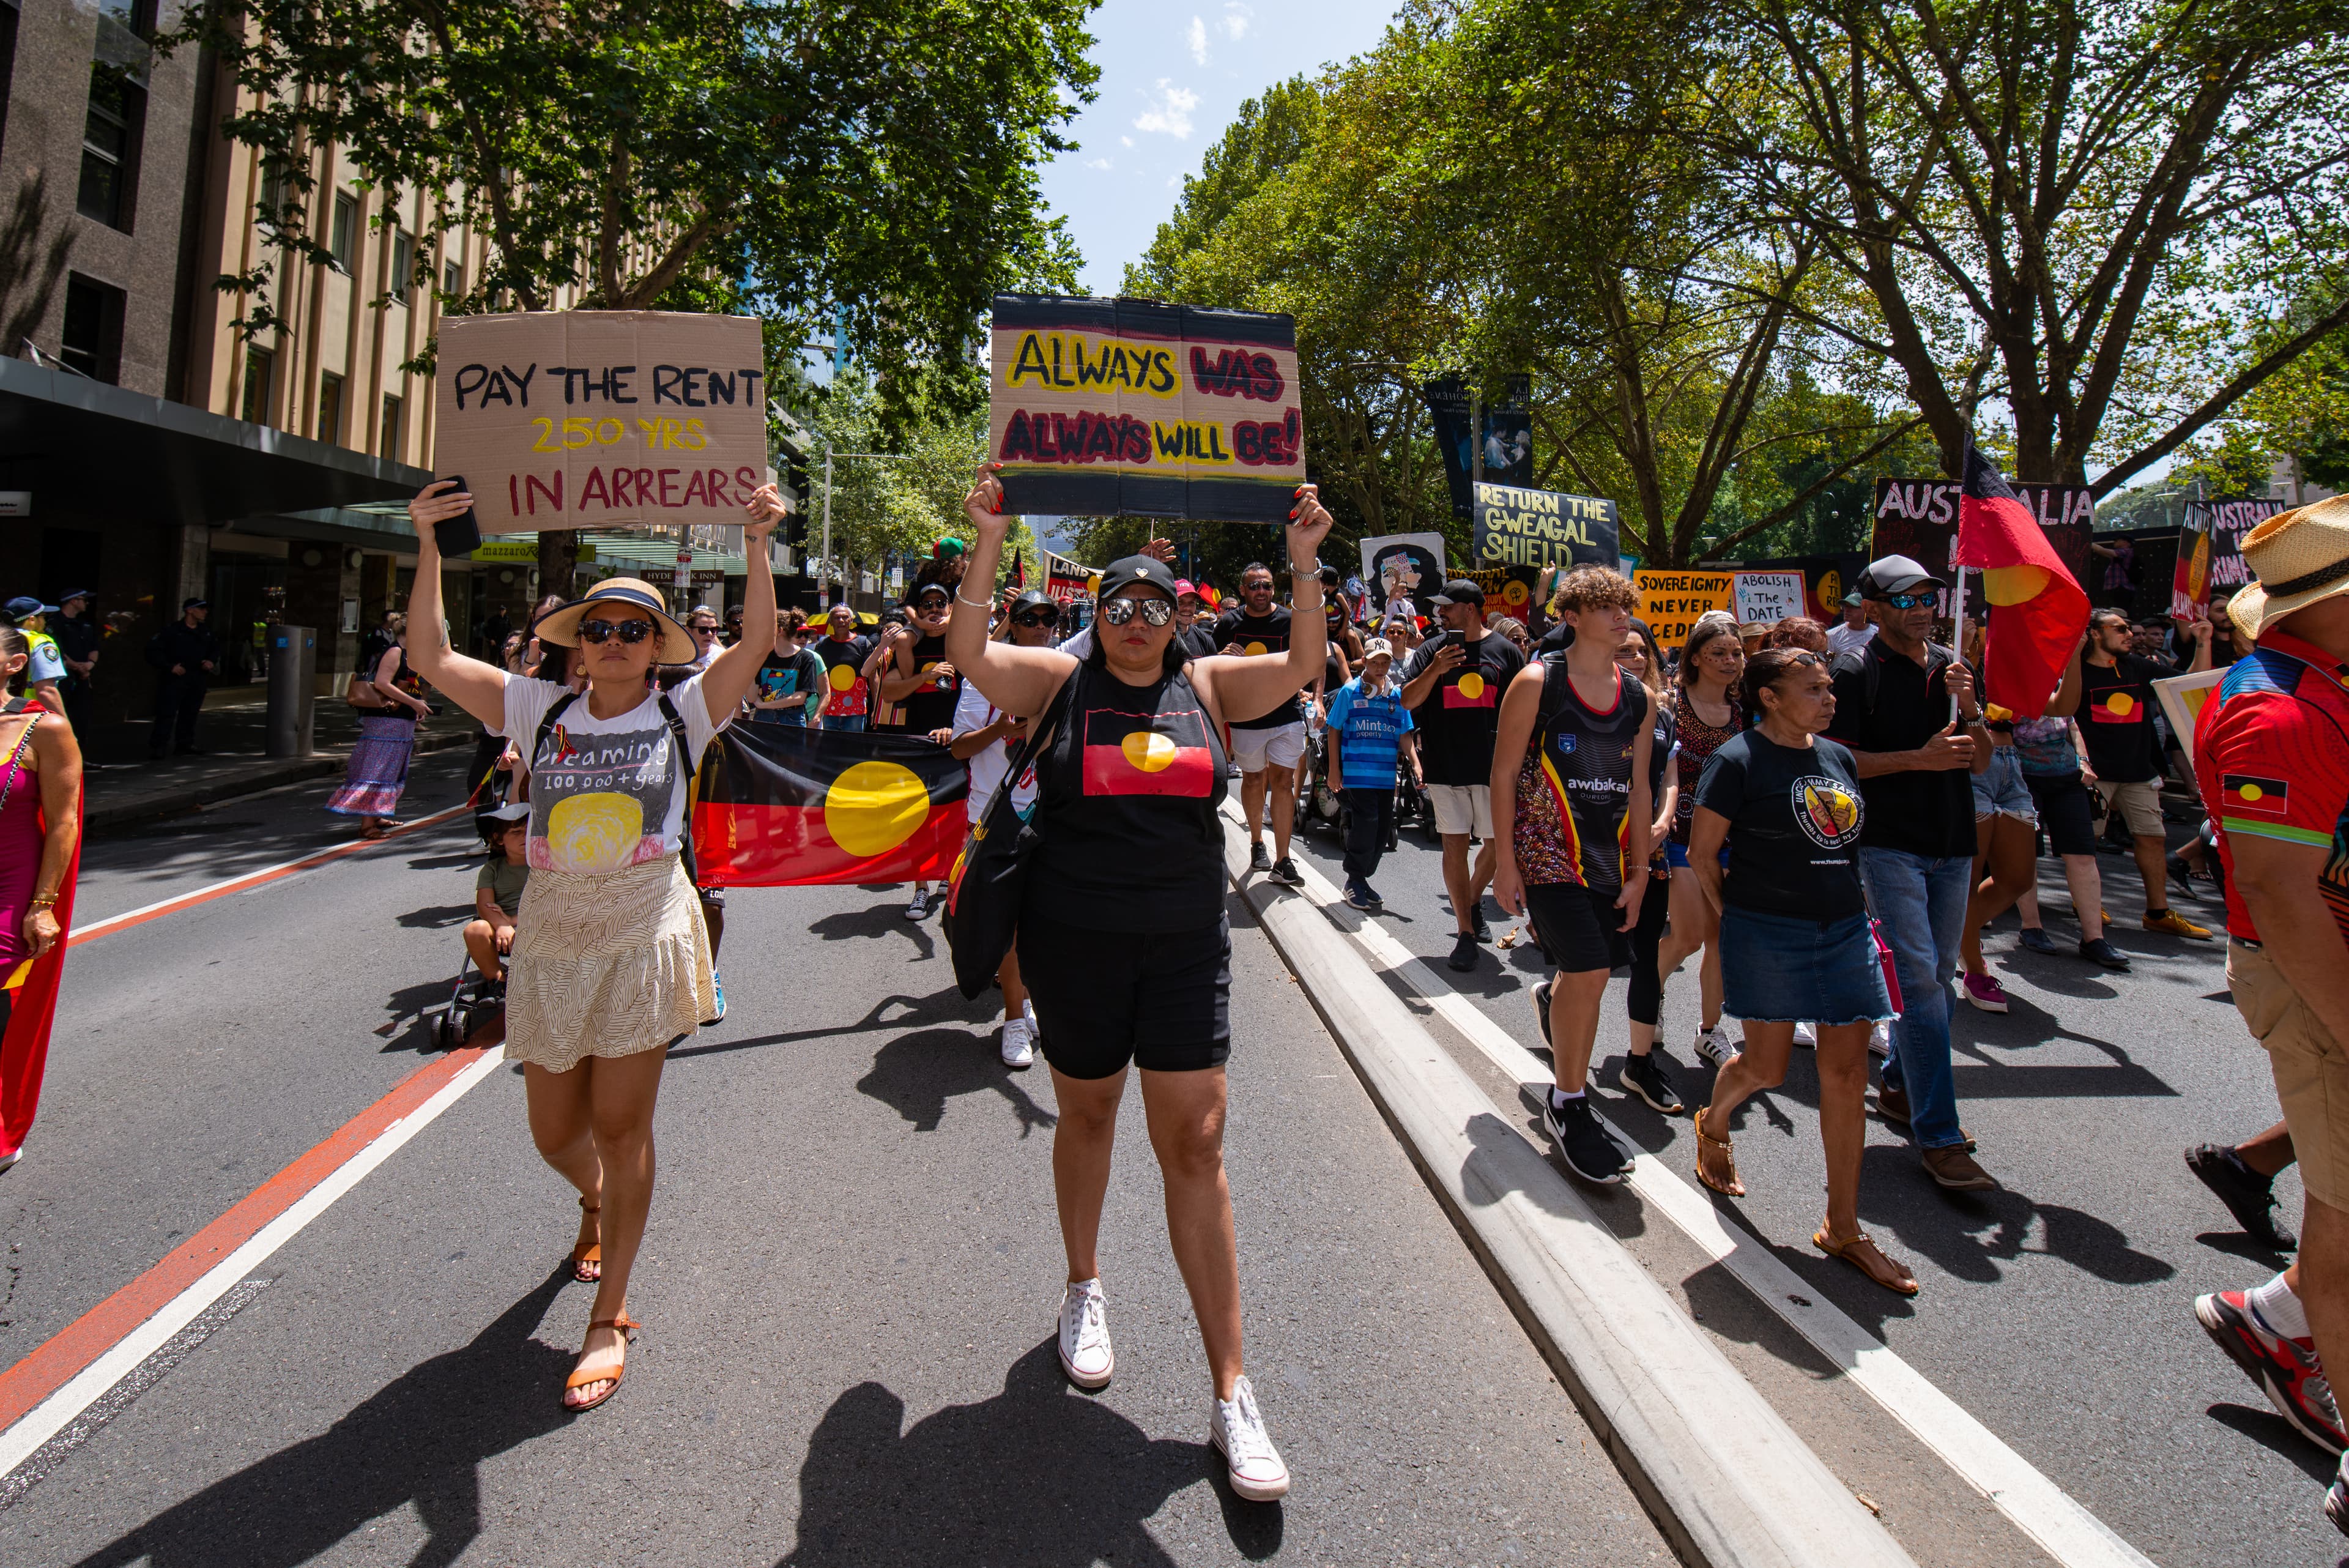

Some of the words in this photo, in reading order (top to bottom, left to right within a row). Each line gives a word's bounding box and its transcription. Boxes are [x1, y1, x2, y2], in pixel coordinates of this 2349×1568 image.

[1009, 331, 1179, 396] ALWAYS
[1191, 346, 1284, 400] WAS
[455, 363, 536, 411] PAY
[546, 366, 639, 405] THE
[653, 364, 763, 407] RENT
[531, 417, 625, 453] 250
[637, 416, 707, 451] YRS
[1001, 409, 1151, 463] ALWAYS
[1154, 420, 1232, 464] WILL
[1234, 408, 1301, 465] BE!
[509, 469, 563, 516] IN
[577, 466, 758, 511] ARREARS
[1479, 485, 1559, 515] RETURN
[1566, 497, 1611, 522] THE
[1877, 481, 2095, 526] AUSALIA
[1485, 508, 1597, 546] GWEAGAL
[2183, 502, 2211, 533] ALWAYS
[482, 546, 526, 556] mazzaro
[1482, 532, 1572, 571] SHIELD
[1052, 557, 1090, 578] LAND
[1742, 575, 1791, 589] ABOLISH
[2210, 553, 2254, 587] RIME
[1638, 575, 1732, 593] SOVEREIGNTY
[1755, 593, 1779, 604] The
[1650, 599, 1713, 613] NEVER
[1748, 606, 1785, 621] DATE
[1650, 623, 1695, 639] CED
[1356, 719, 1381, 731] Mint
[536, 736, 672, 767] Dreaming
[632, 771, 674, 791] years
[1800, 811, 1816, 836] Thumbs
